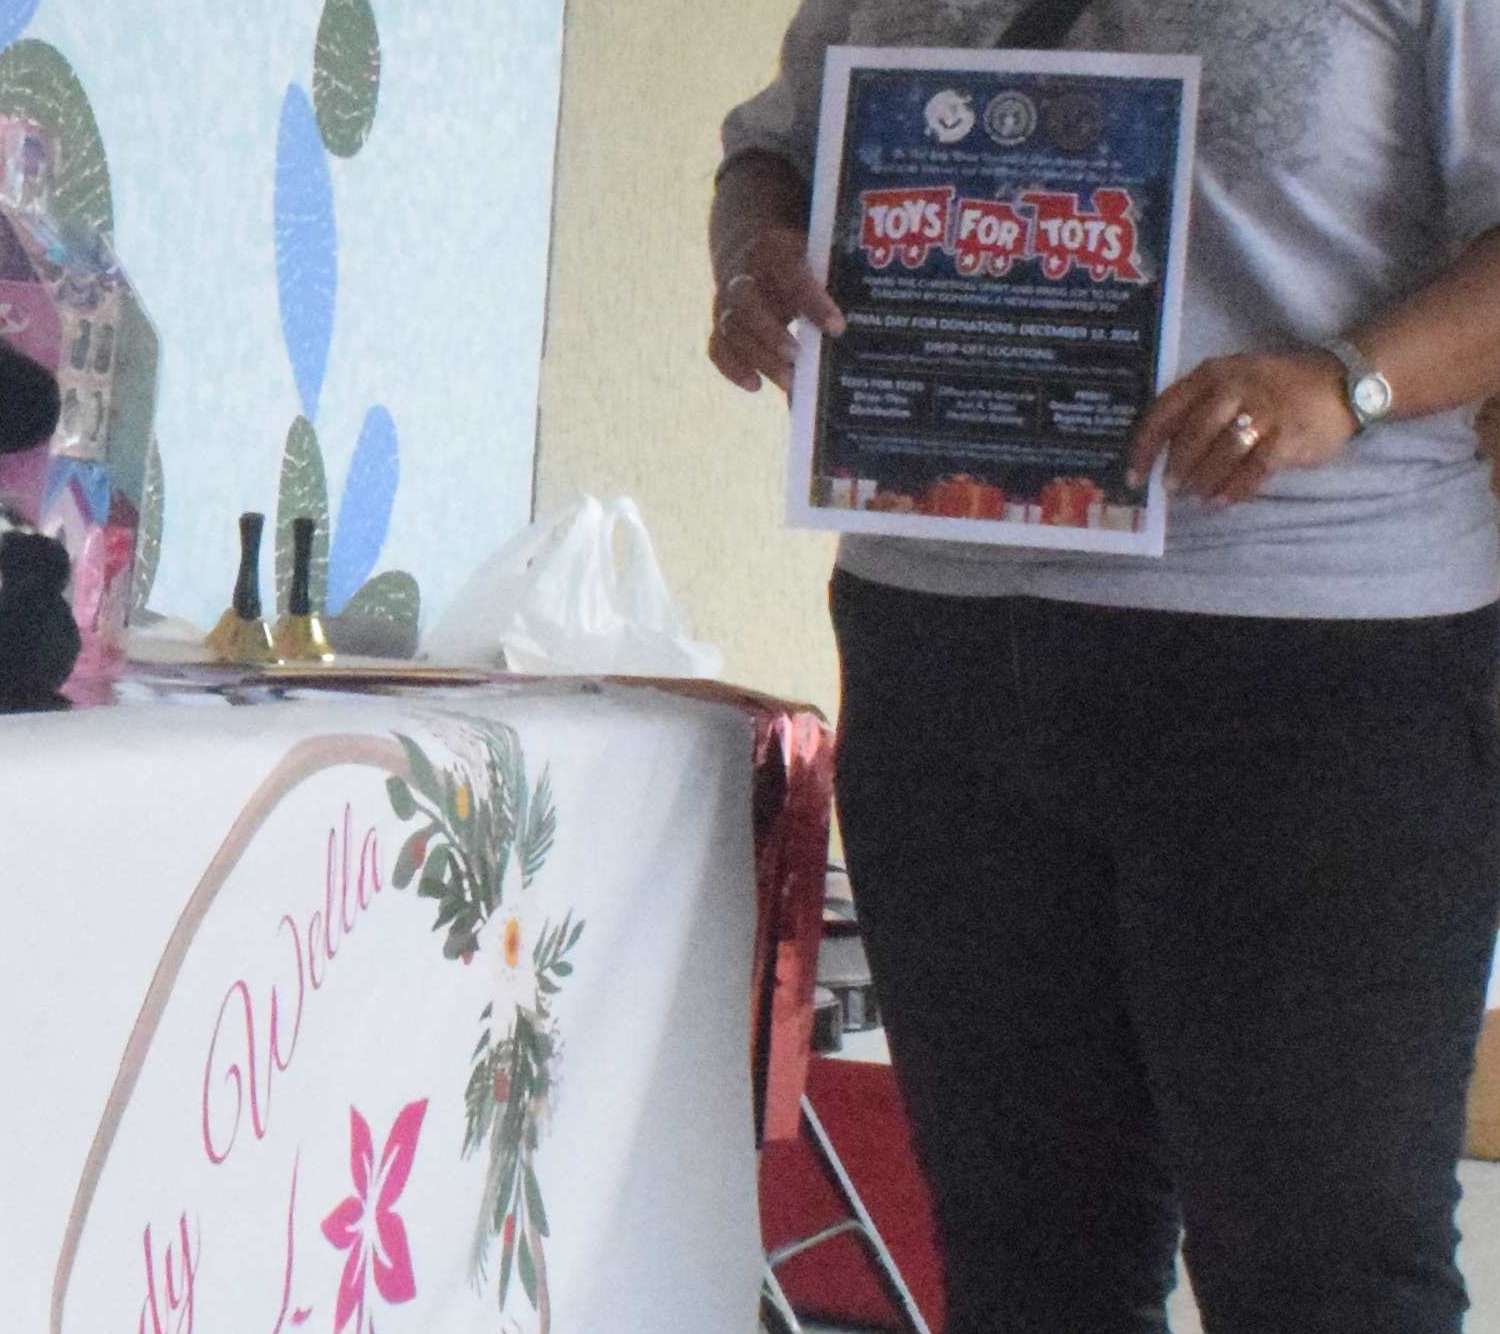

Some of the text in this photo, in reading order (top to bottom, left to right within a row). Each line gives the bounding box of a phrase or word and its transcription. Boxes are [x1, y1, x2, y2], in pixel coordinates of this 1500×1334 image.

[868, 199, 1123, 260] TOYS FOR TOTS
[201, 802, 382, 1165] Wella
